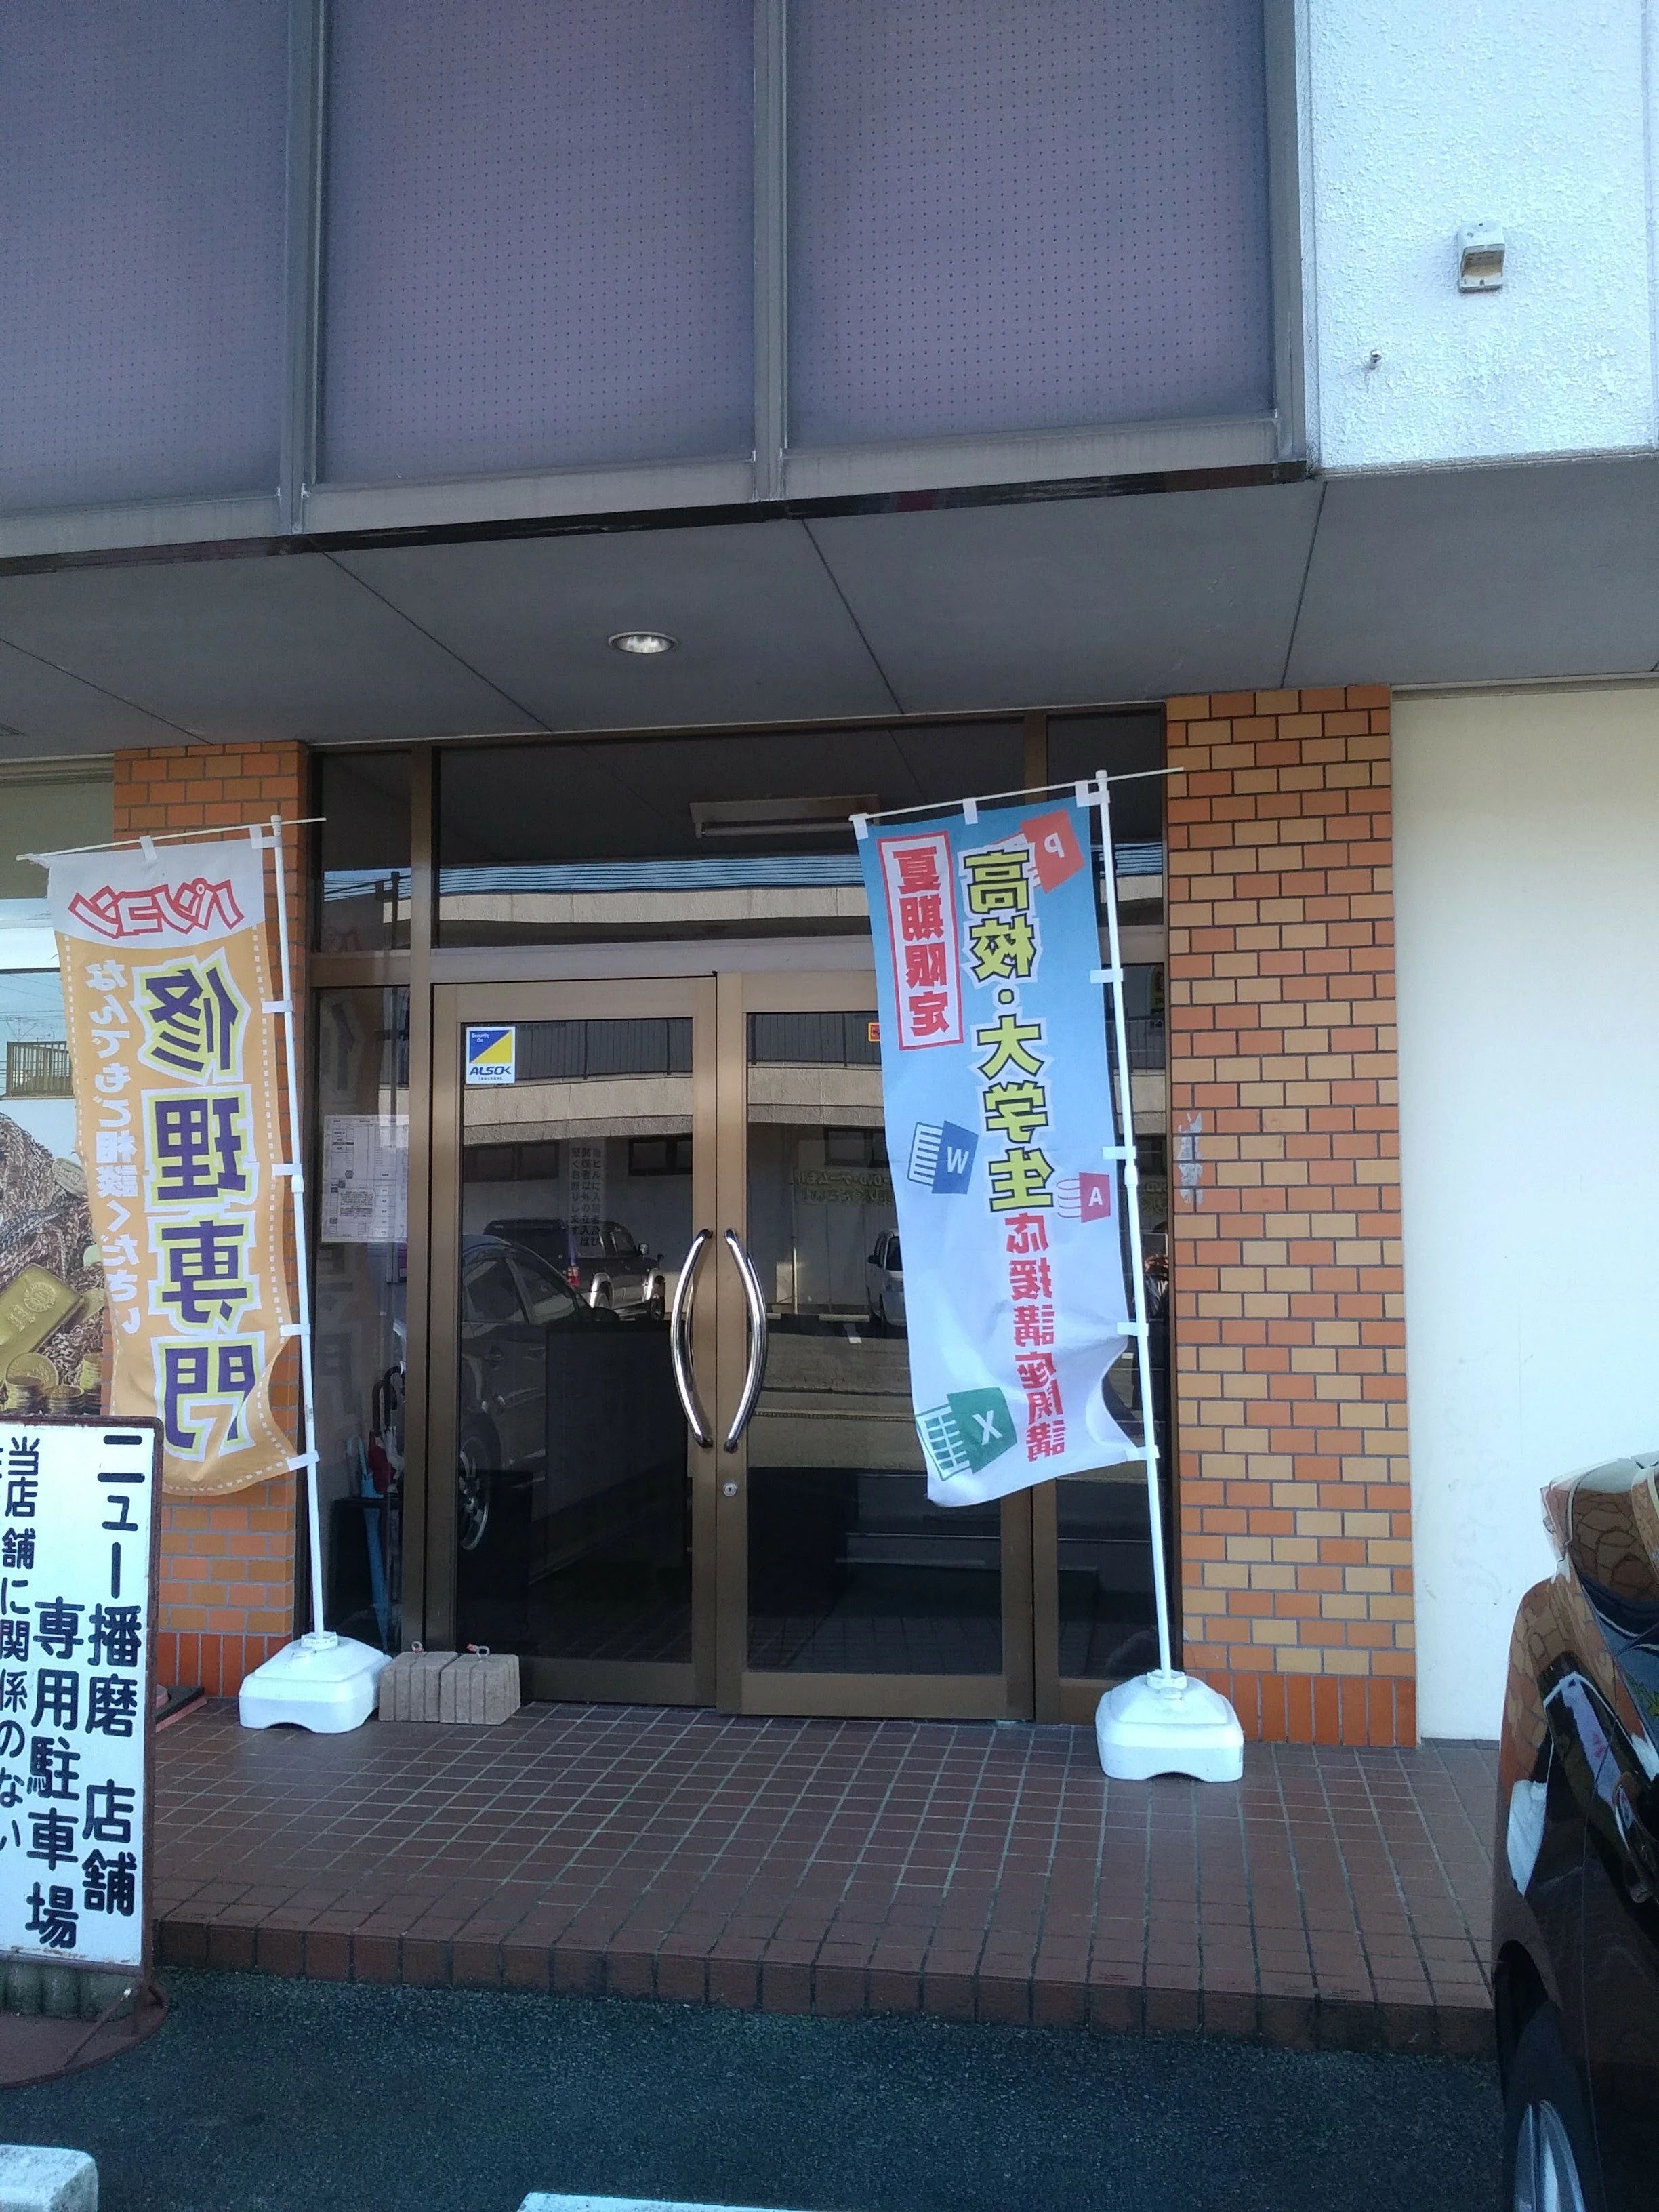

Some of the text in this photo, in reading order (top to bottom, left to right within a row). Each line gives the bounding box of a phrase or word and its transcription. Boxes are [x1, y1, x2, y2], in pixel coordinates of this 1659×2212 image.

[469, 1066, 511, 1076] ALSOK
[25, 1595, 86, 1950] 専用駐車場
